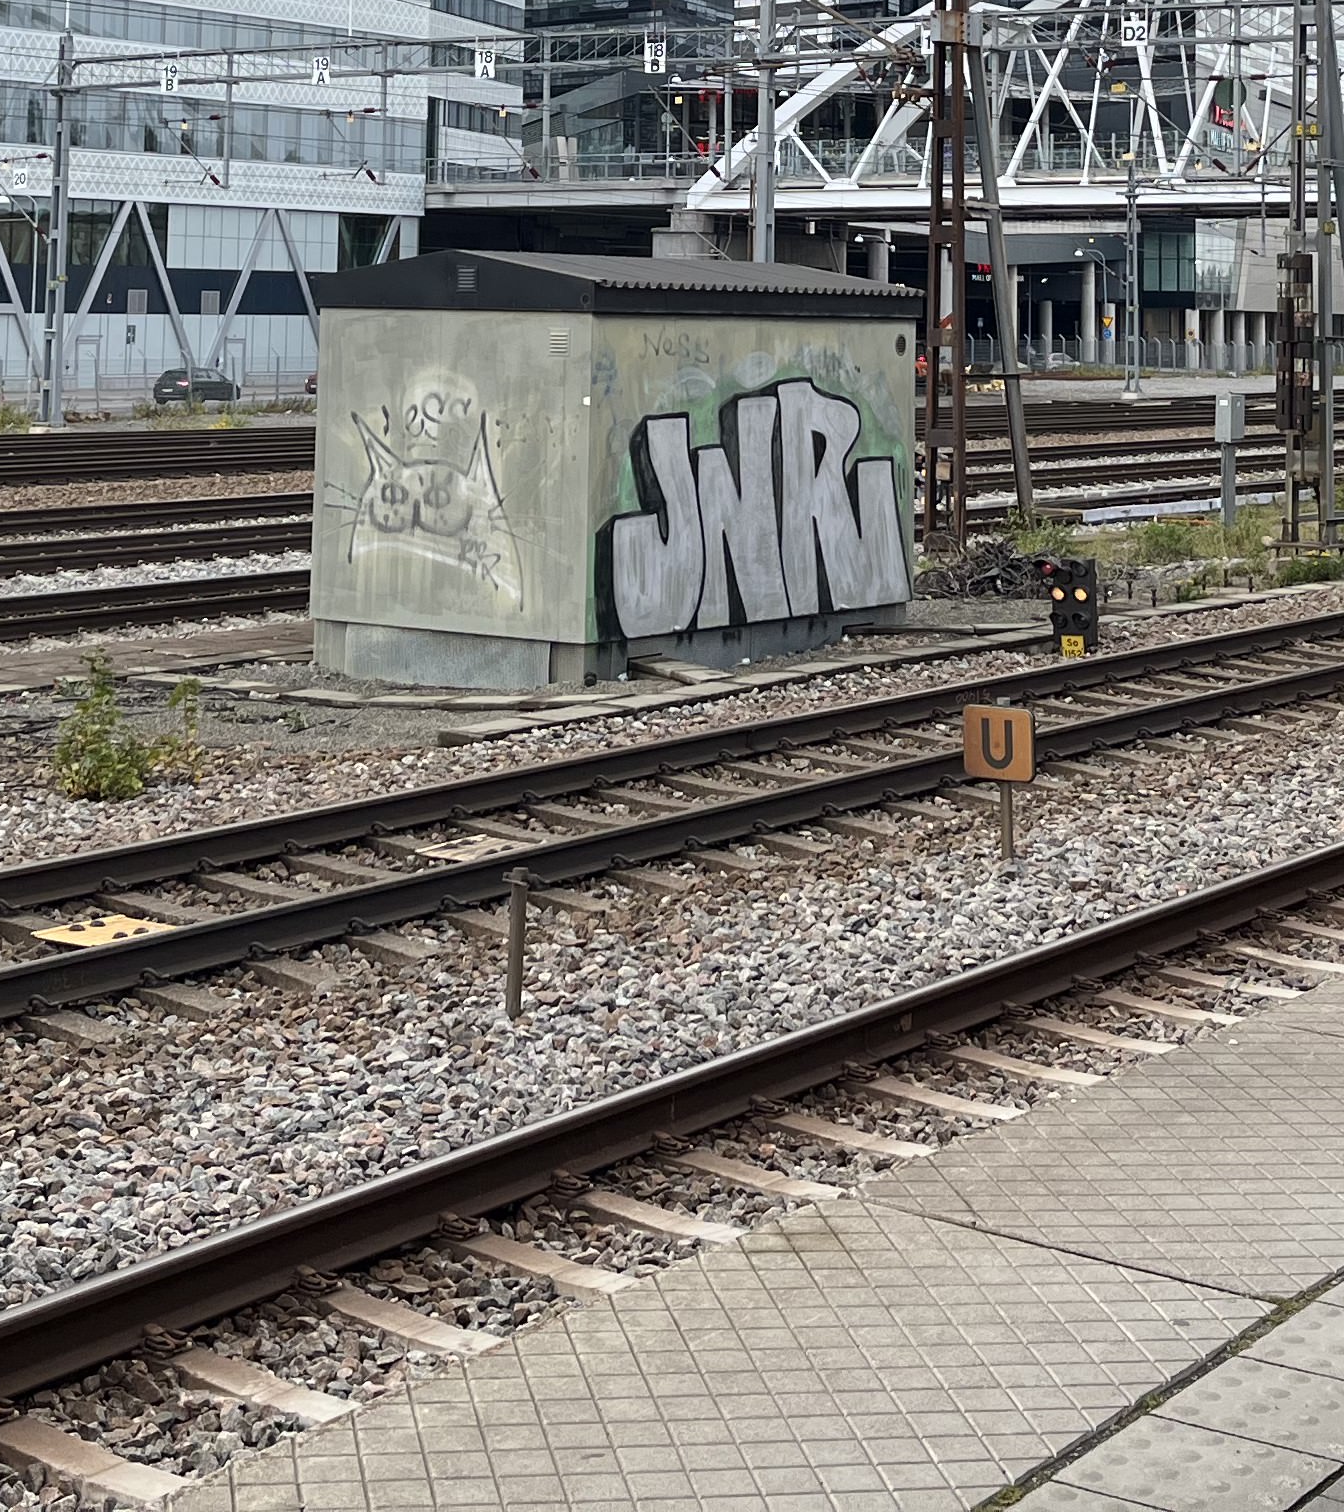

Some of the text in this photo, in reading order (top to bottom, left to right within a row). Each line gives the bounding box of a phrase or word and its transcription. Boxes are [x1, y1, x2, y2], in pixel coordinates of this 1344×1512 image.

[1123, 26, 1146, 41] D2
[478, 50, 493, 63] 18
[648, 43, 664, 58] 18
[314, 57, 329, 71] 19
[651, 58, 660, 72] B
[163, 65, 178, 78] 19
[480, 65, 490, 78] A
[166, 79, 174, 91] B
[317, 75, 325, 84] A
[14, 172, 26, 186] 20
[981, 718, 1013, 770] U
